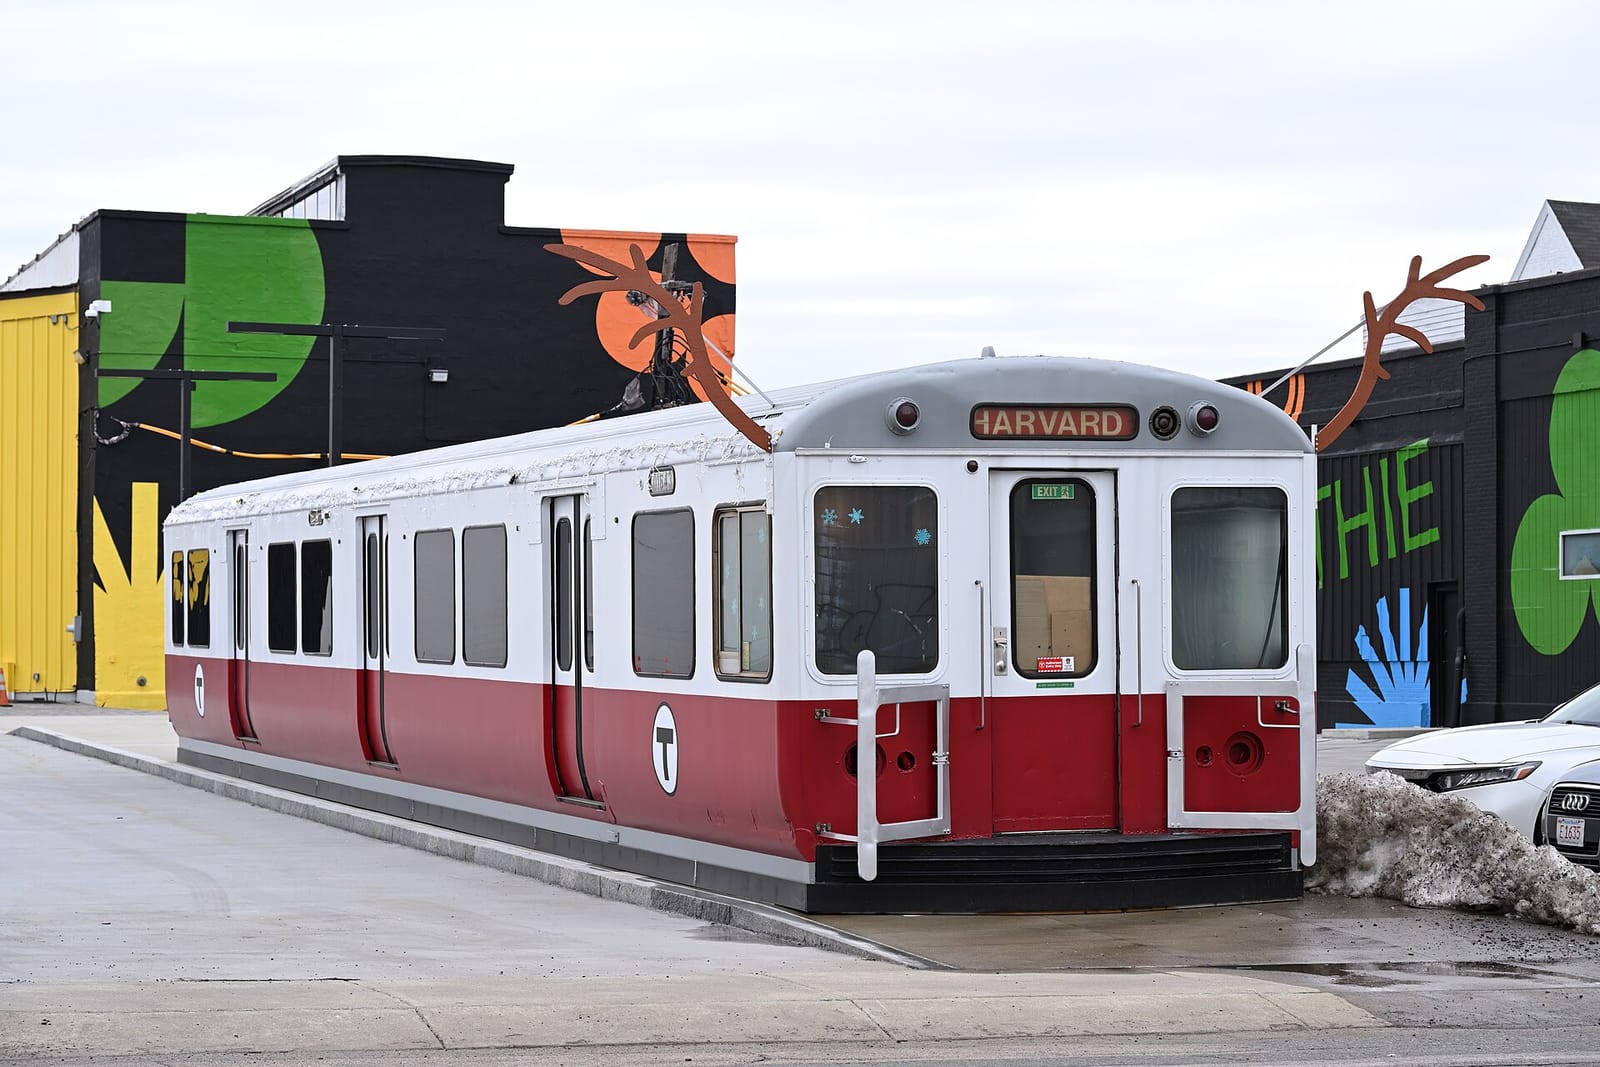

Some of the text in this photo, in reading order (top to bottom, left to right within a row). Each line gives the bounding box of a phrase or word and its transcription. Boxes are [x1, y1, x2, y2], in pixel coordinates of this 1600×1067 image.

[975, 410, 1123, 436] HARVARD
[1037, 486, 1058, 497] EXIT
[196, 677, 203, 709] T
[656, 727, 674, 781] T
